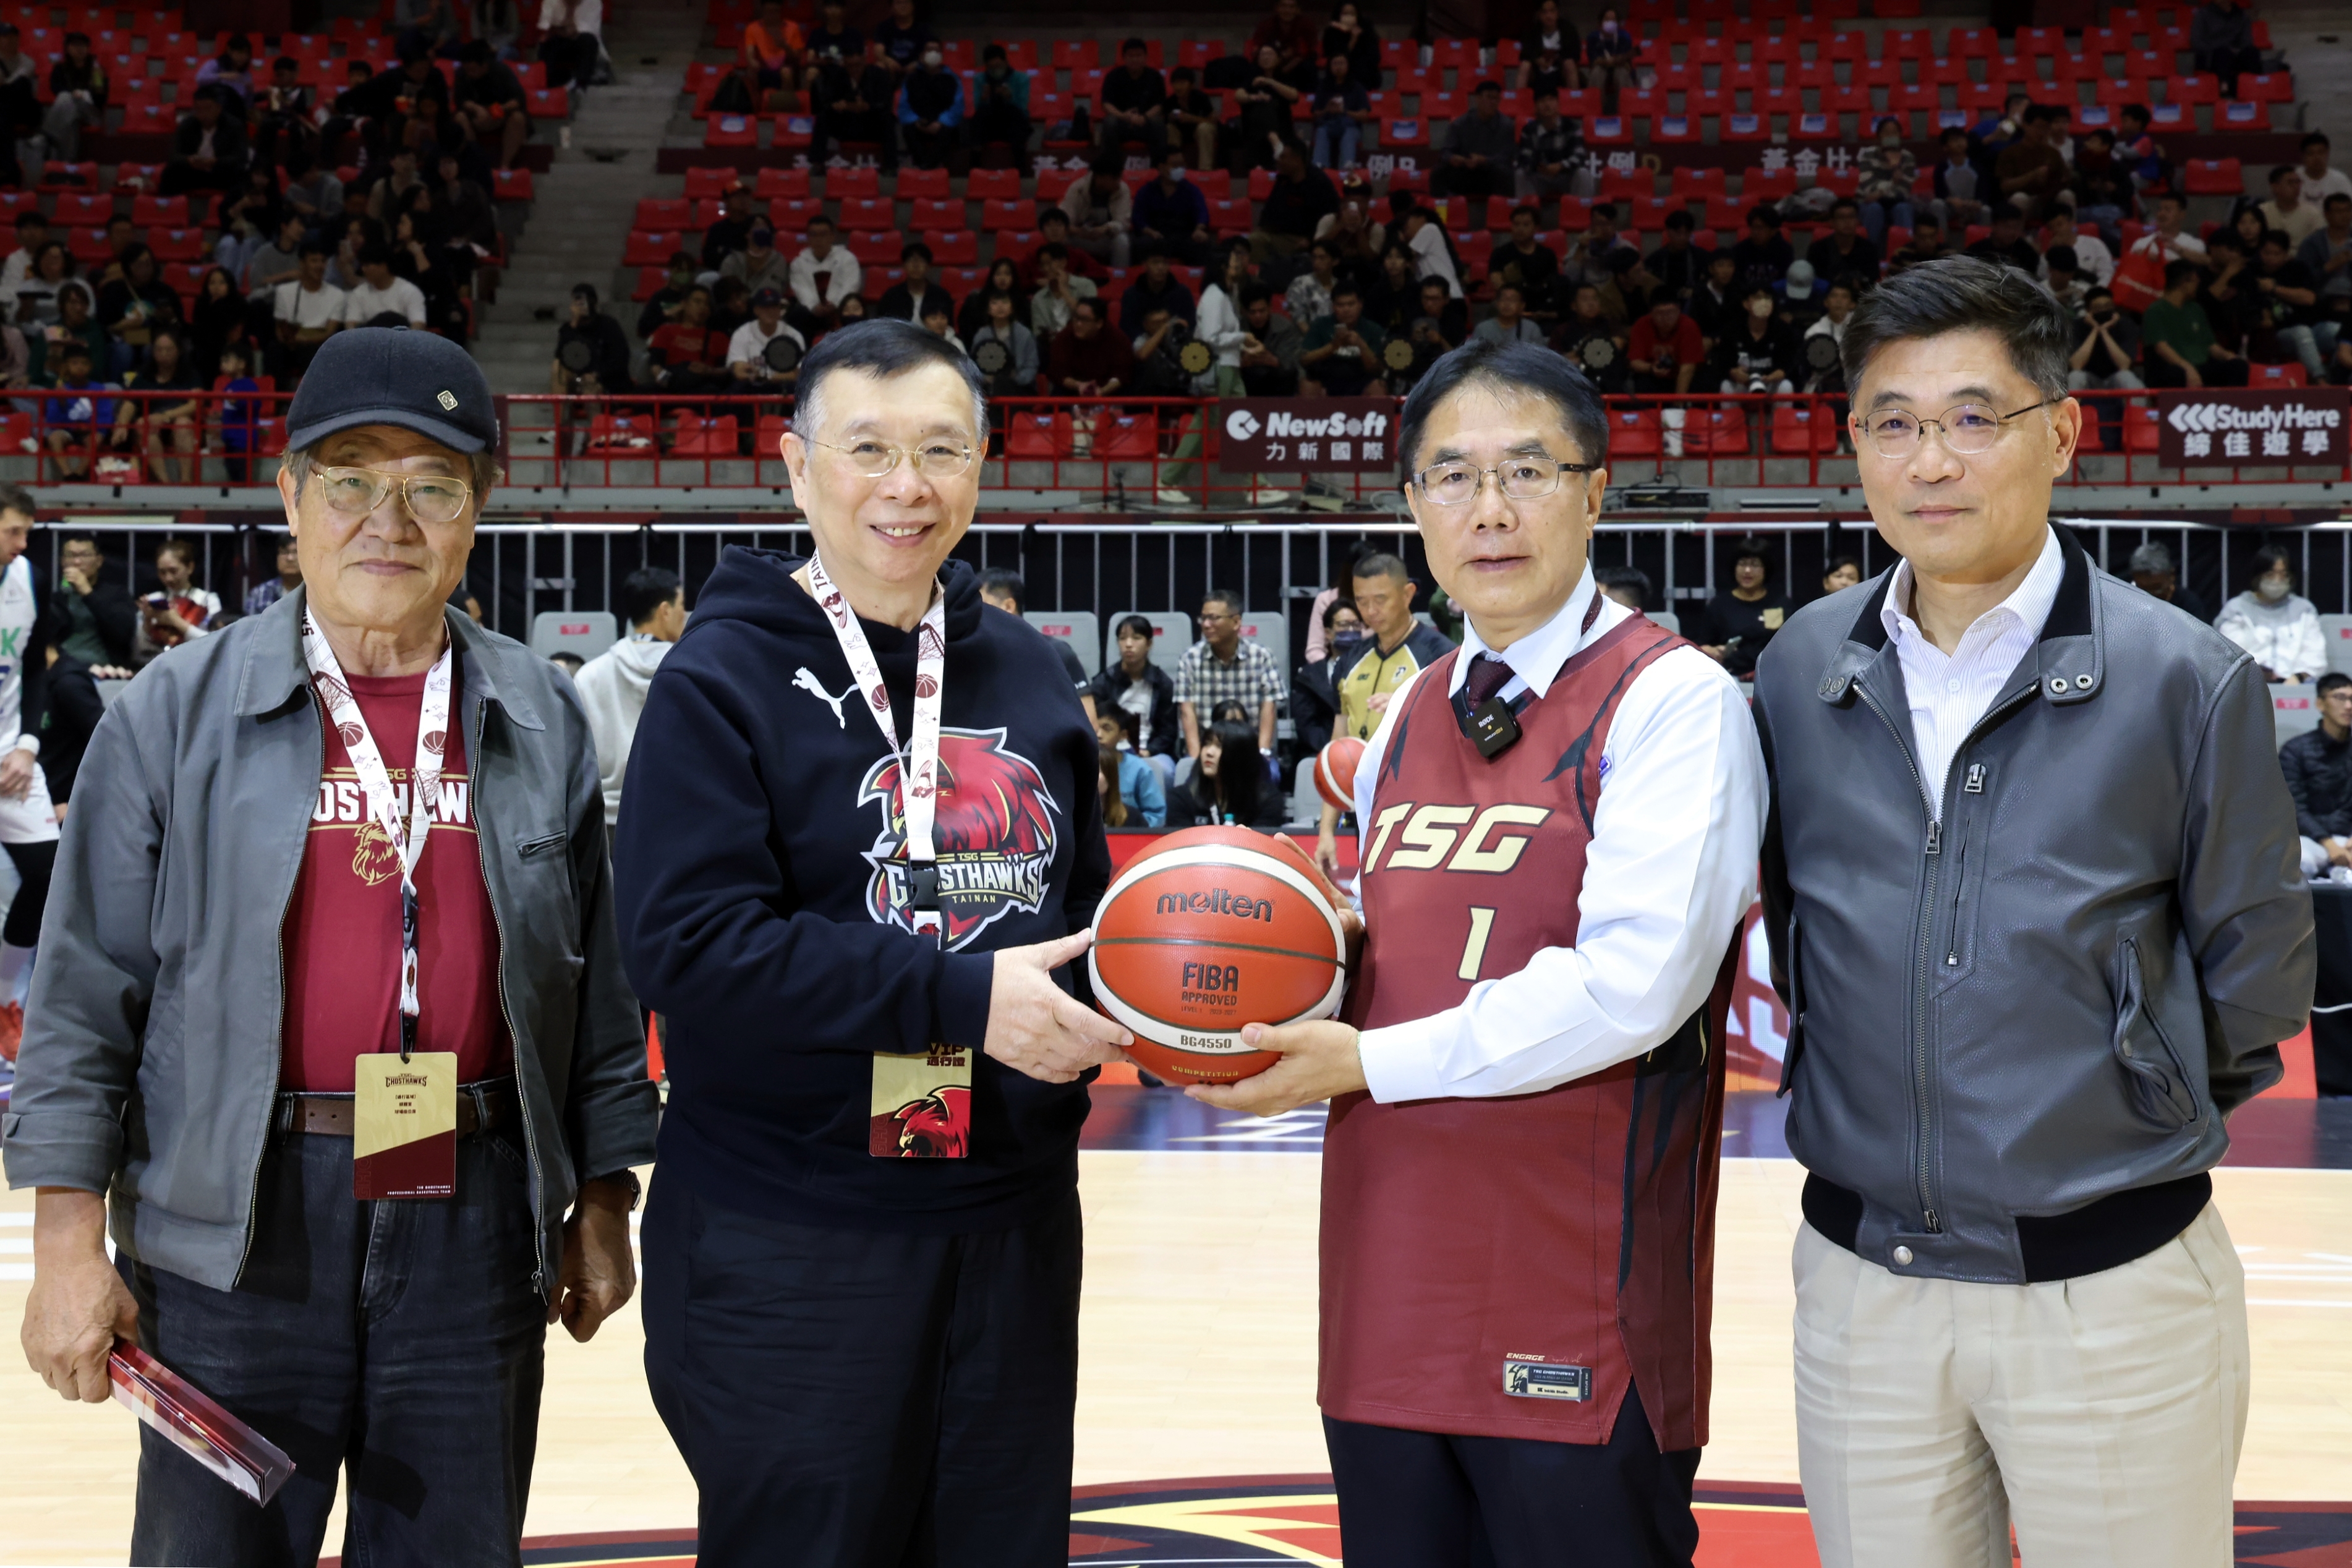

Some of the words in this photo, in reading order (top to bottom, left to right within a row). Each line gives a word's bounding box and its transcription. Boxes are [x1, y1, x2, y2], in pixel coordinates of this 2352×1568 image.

[1266, 411, 1387, 437] NewSoft
[2216, 403, 2340, 433] StudyHere
[1266, 441, 1384, 461] 力新國際
[1357, 801, 1556, 878] TSG
[957, 853, 979, 861] TSG
[882, 856, 1045, 911] GSTHAWKS
[952, 895, 996, 904] TAINAN
[1156, 888, 1274, 922] molten
[1456, 905, 1498, 982] 1
[1182, 962, 1240, 992] FIBA
[1182, 991, 1237, 1007] APPROVED
[1180, 1034, 1232, 1049] BG4550
[1172, 1065, 1238, 1077] COMPETITION
[1506, 1352, 1545, 1361] ENGAGE
